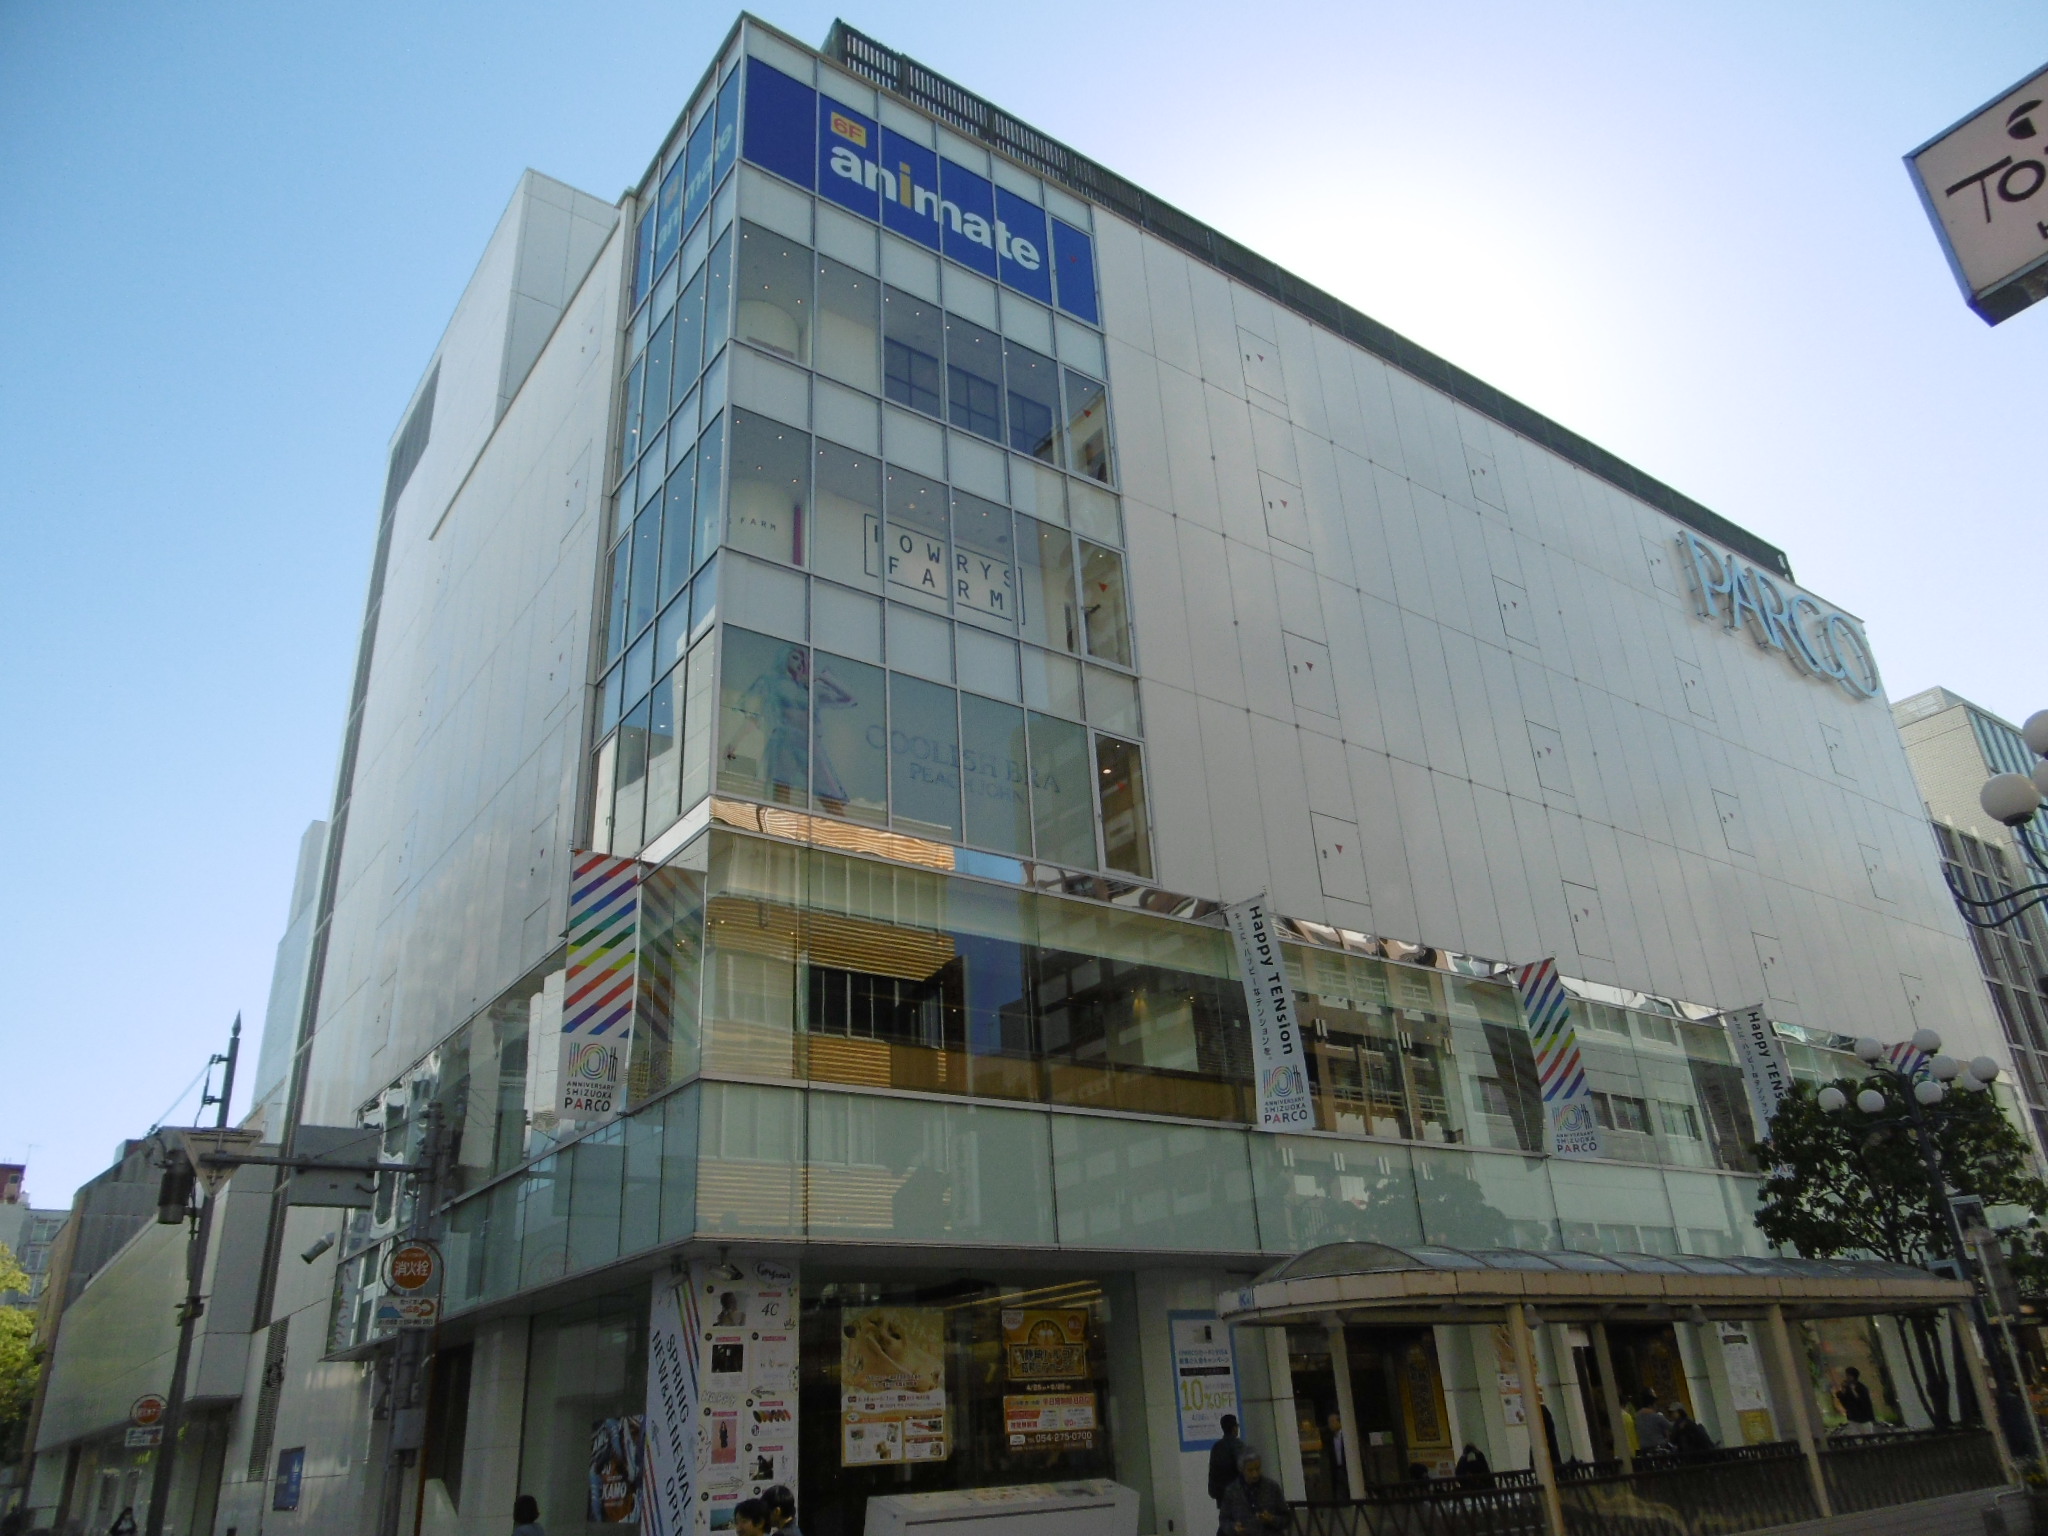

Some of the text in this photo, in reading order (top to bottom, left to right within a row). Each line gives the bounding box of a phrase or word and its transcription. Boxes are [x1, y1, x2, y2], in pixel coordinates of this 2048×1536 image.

[833, 116, 863, 139] 6F
[1945, 154, 2048, 224] TO
[829, 145, 1042, 272] animate
[888, 557, 1004, 612] FARM
[1679, 530, 1882, 700] PARCO
[865, 723, 999, 777] COOLISH
[1249, 905, 1274, 967] Happy
[1747, 1011, 1771, 1058] Happy
[566, 1080, 615, 1091] ANNIVERSARY
[566, 1087, 613, 1099] SHIZUOKA
[564, 1097, 611, 1113] PARCO
[1264, 1096, 1305, 1107] ANNIVERSARY
[1264, 1103, 1306, 1114] SHIZUOKA
[1264, 1109, 1308, 1124] PARCO
[1556, 1136, 1596, 1144] SHIZUOKA
[1557, 1142, 1597, 1153] PARCO
[394, 1260, 429, 1278] 消火栓
[667, 1333, 690, 1424] SPRING
